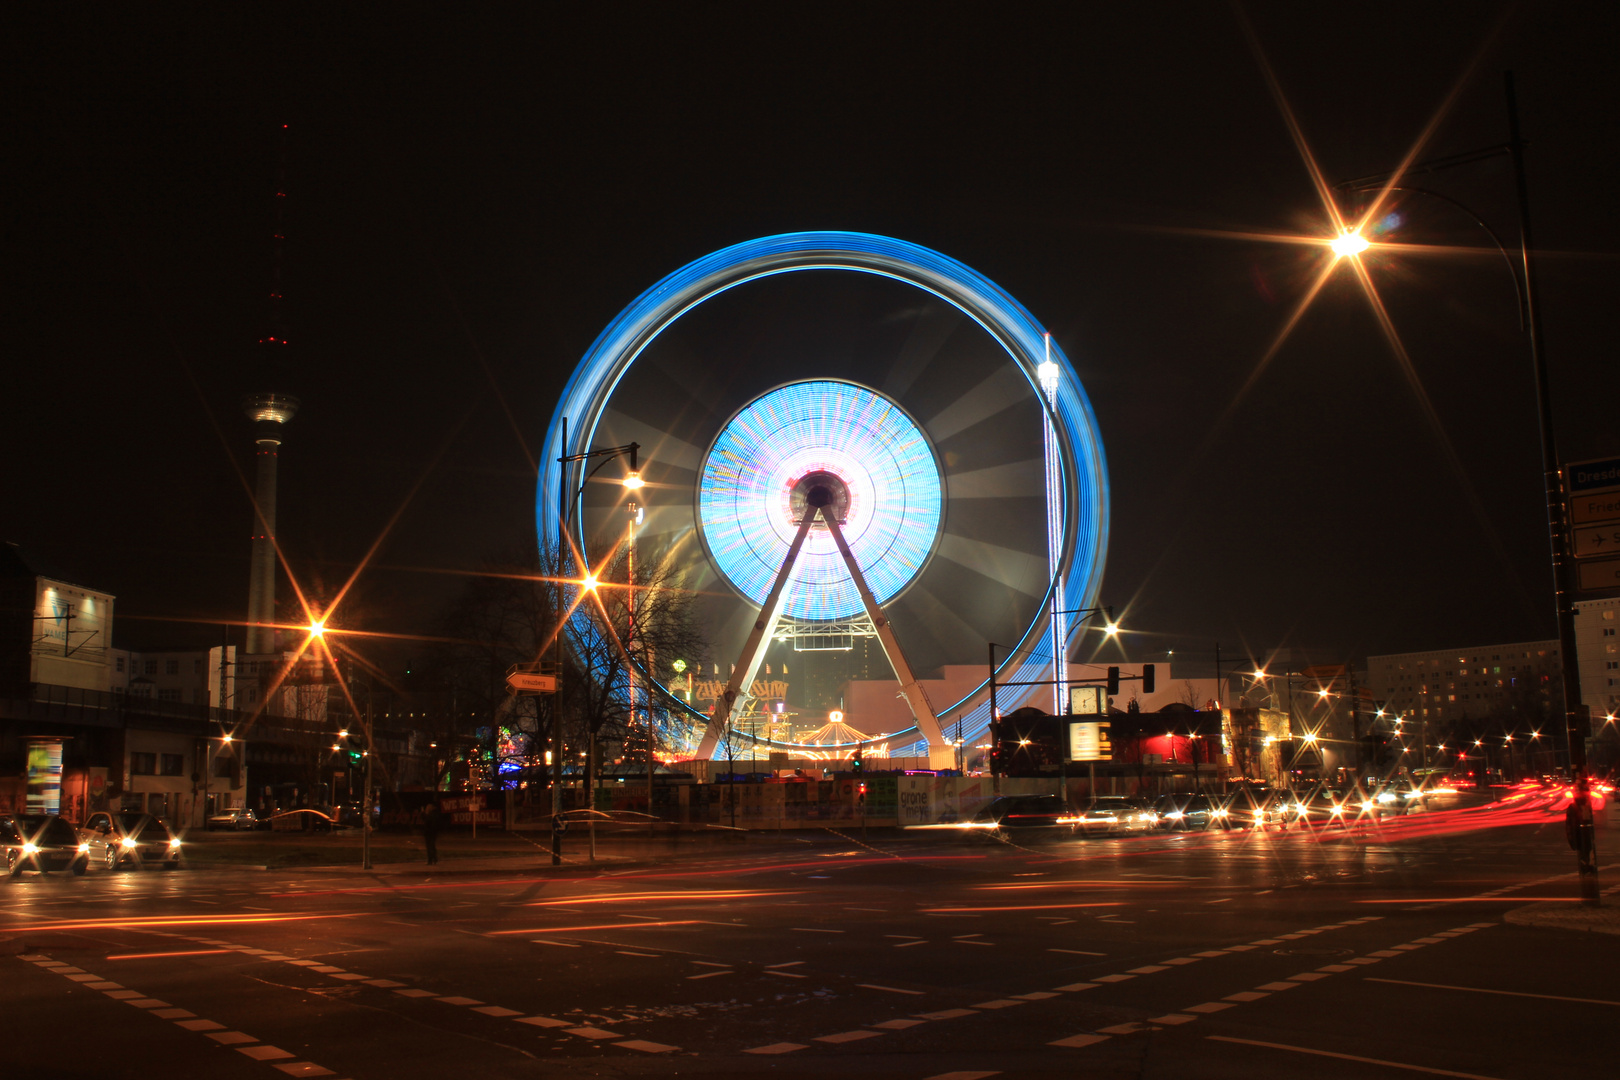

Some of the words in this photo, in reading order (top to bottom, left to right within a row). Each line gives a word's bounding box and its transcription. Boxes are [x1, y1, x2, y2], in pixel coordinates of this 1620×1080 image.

[44, 628, 71, 641] VAME
[442, 799, 458, 811] WE
[453, 812, 472, 822] YOU
